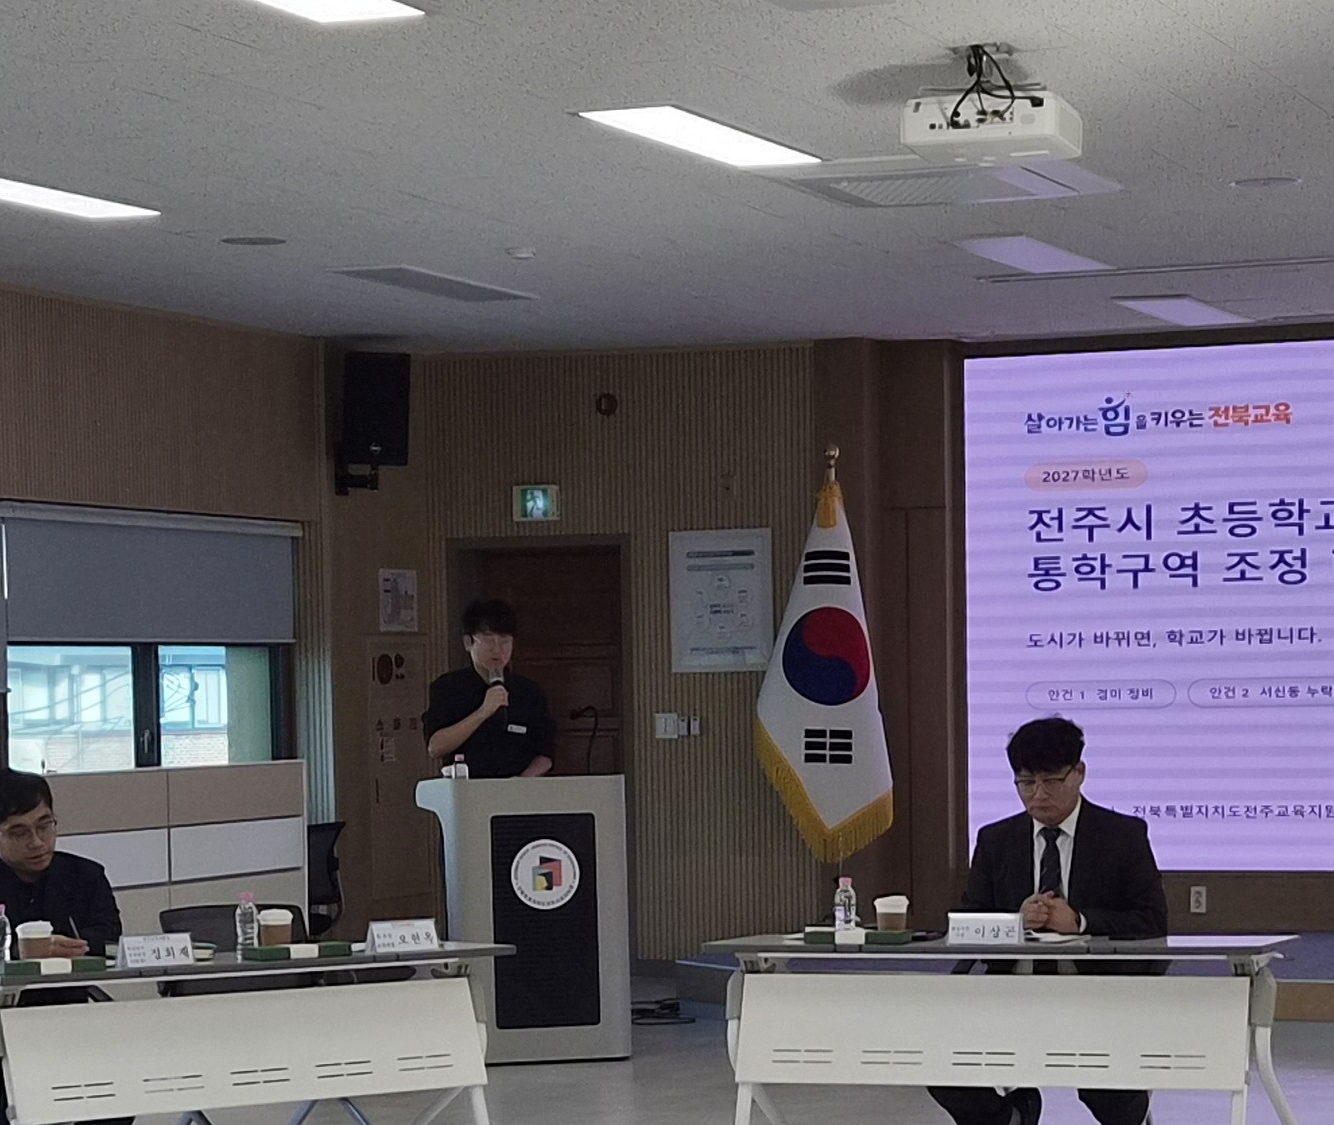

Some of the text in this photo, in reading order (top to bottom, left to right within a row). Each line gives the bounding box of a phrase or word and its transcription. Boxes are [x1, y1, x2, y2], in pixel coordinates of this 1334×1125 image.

[1024, 412, 1098, 434] 살아가는
[1150, 409, 1205, 428] 키우는
[1208, 402, 1293, 428] 전북교육
[1042, 467, 1130, 483] 2027학년도
[1027, 504, 1154, 543] 전주시
[1027, 550, 1200, 592] 통학구역
[1222, 547, 1309, 585] 조정
[1026, 626, 1322, 649] 도시가 바뀌면, 학교가 바뀝니다.
[1048, 688, 1073, 702] 안건
[1209, 686, 1236, 700] 안건
[1241, 688, 1249, 698] 2
[1260, 685, 1300, 699] 서신동
